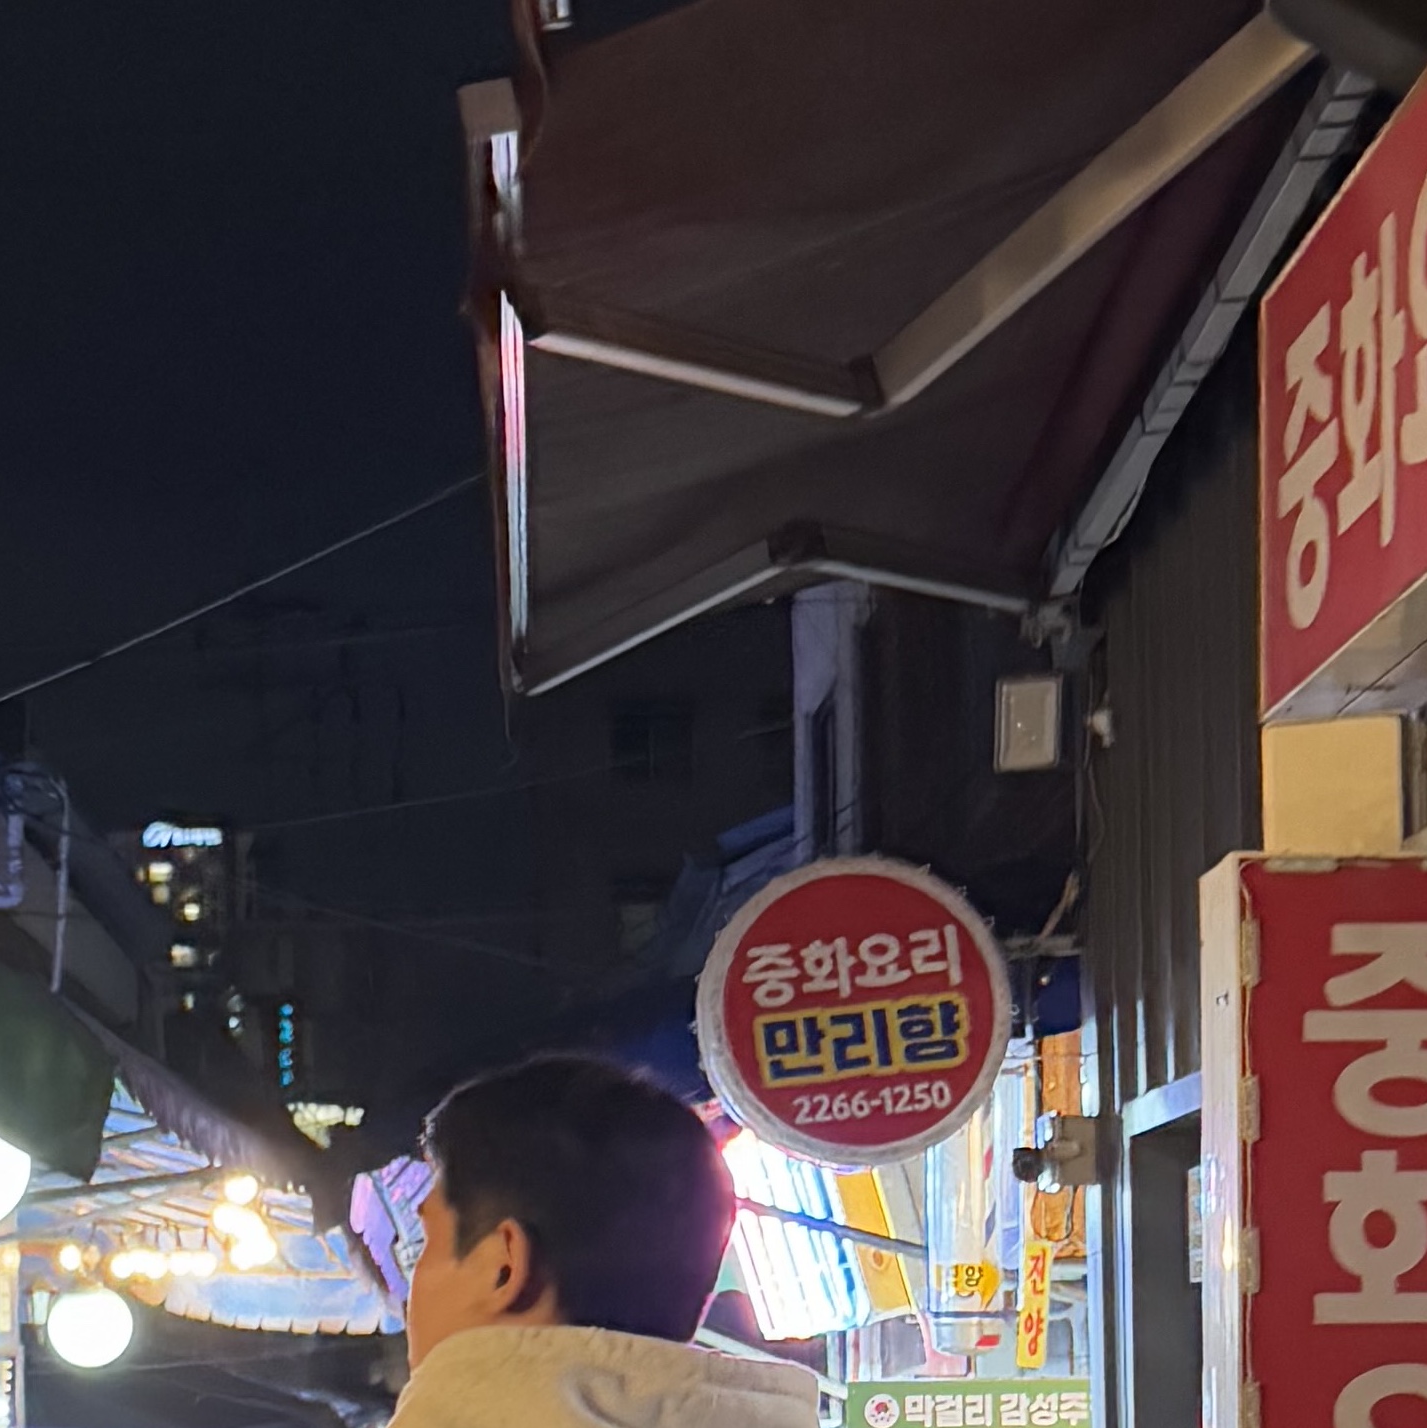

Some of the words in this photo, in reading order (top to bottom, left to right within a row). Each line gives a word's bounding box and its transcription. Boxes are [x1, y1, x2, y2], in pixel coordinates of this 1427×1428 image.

[743, 924, 963, 1008] 중화요리
[760, 997, 966, 1083] 만리향
[793, 1080, 952, 1125] 2266-1250
[1024, 1248, 1047, 1357] 진양
[904, 1392, 993, 1428] 막걸리
[999, 1392, 1091, 1428] 감성주
